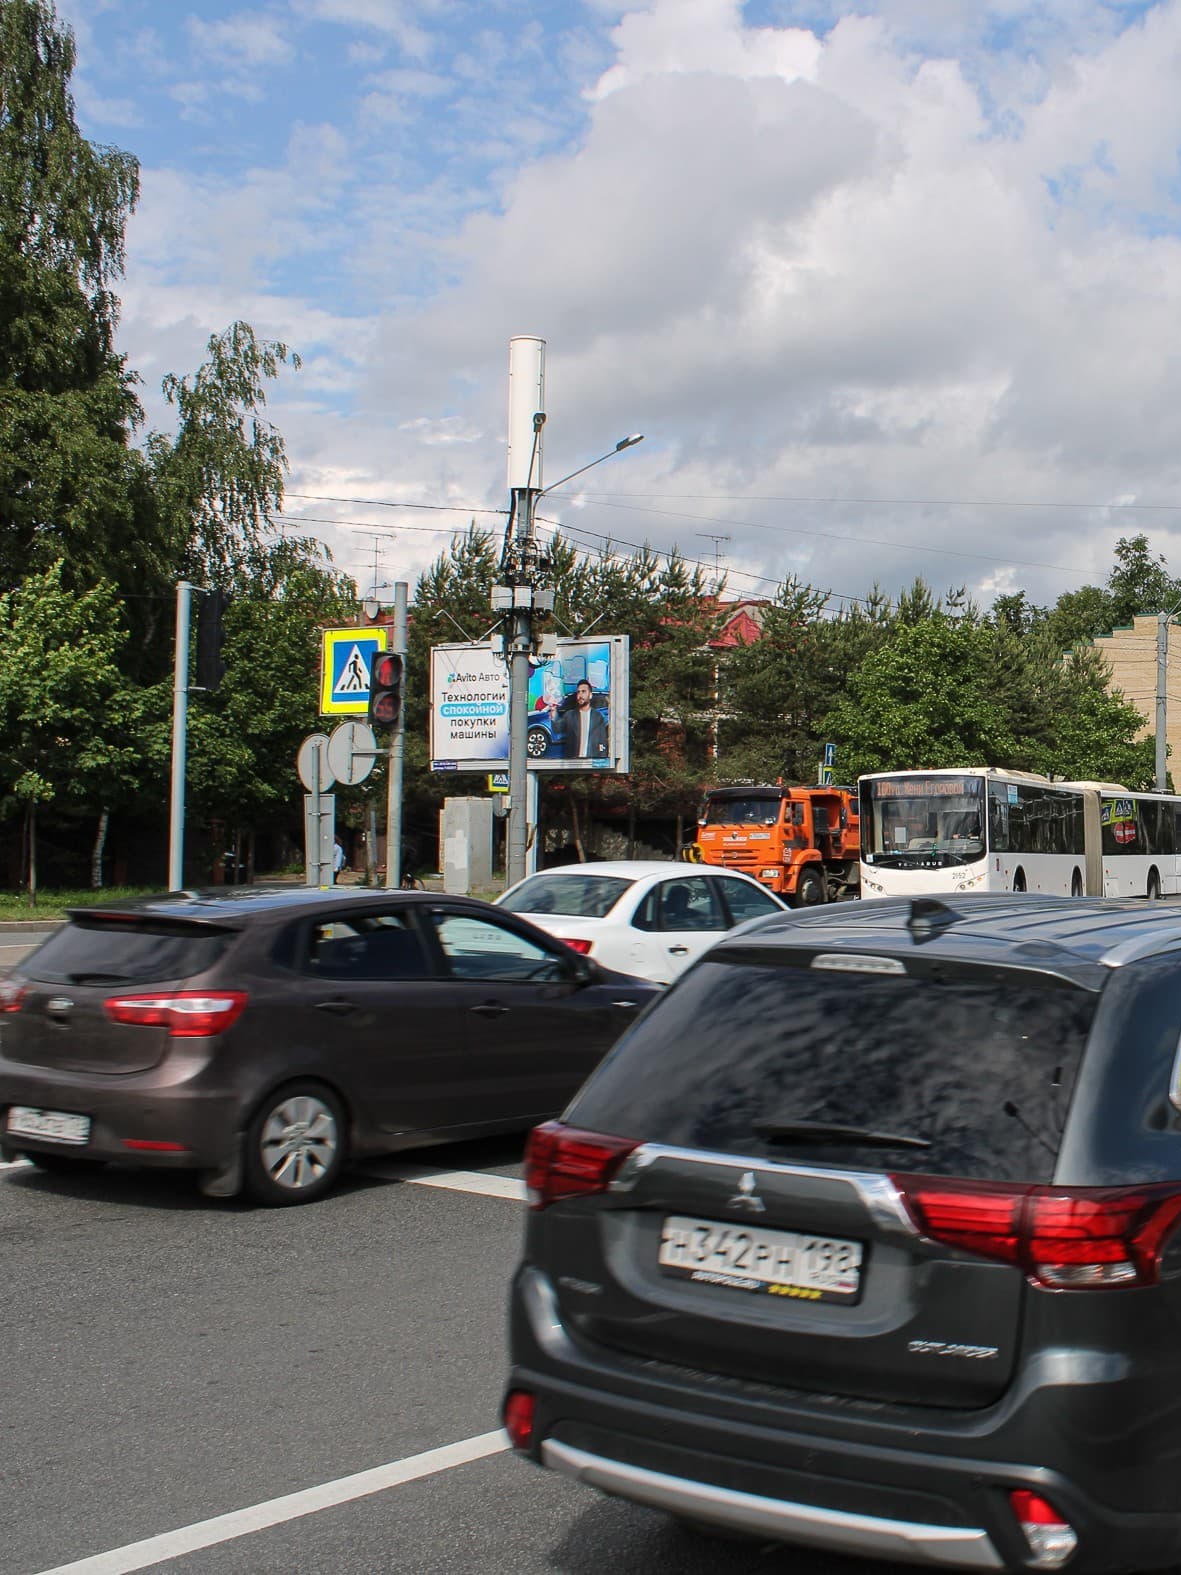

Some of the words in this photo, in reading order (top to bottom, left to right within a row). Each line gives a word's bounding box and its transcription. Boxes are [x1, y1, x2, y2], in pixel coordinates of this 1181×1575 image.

[456, 672, 477, 682] Avito
[479, 672, 500, 681] Авто
[441, 692, 506, 702] Технологии
[442, 703, 504, 715] спокойной
[450, 718, 497, 729] покупки
[450, 731, 497, 739] машины
